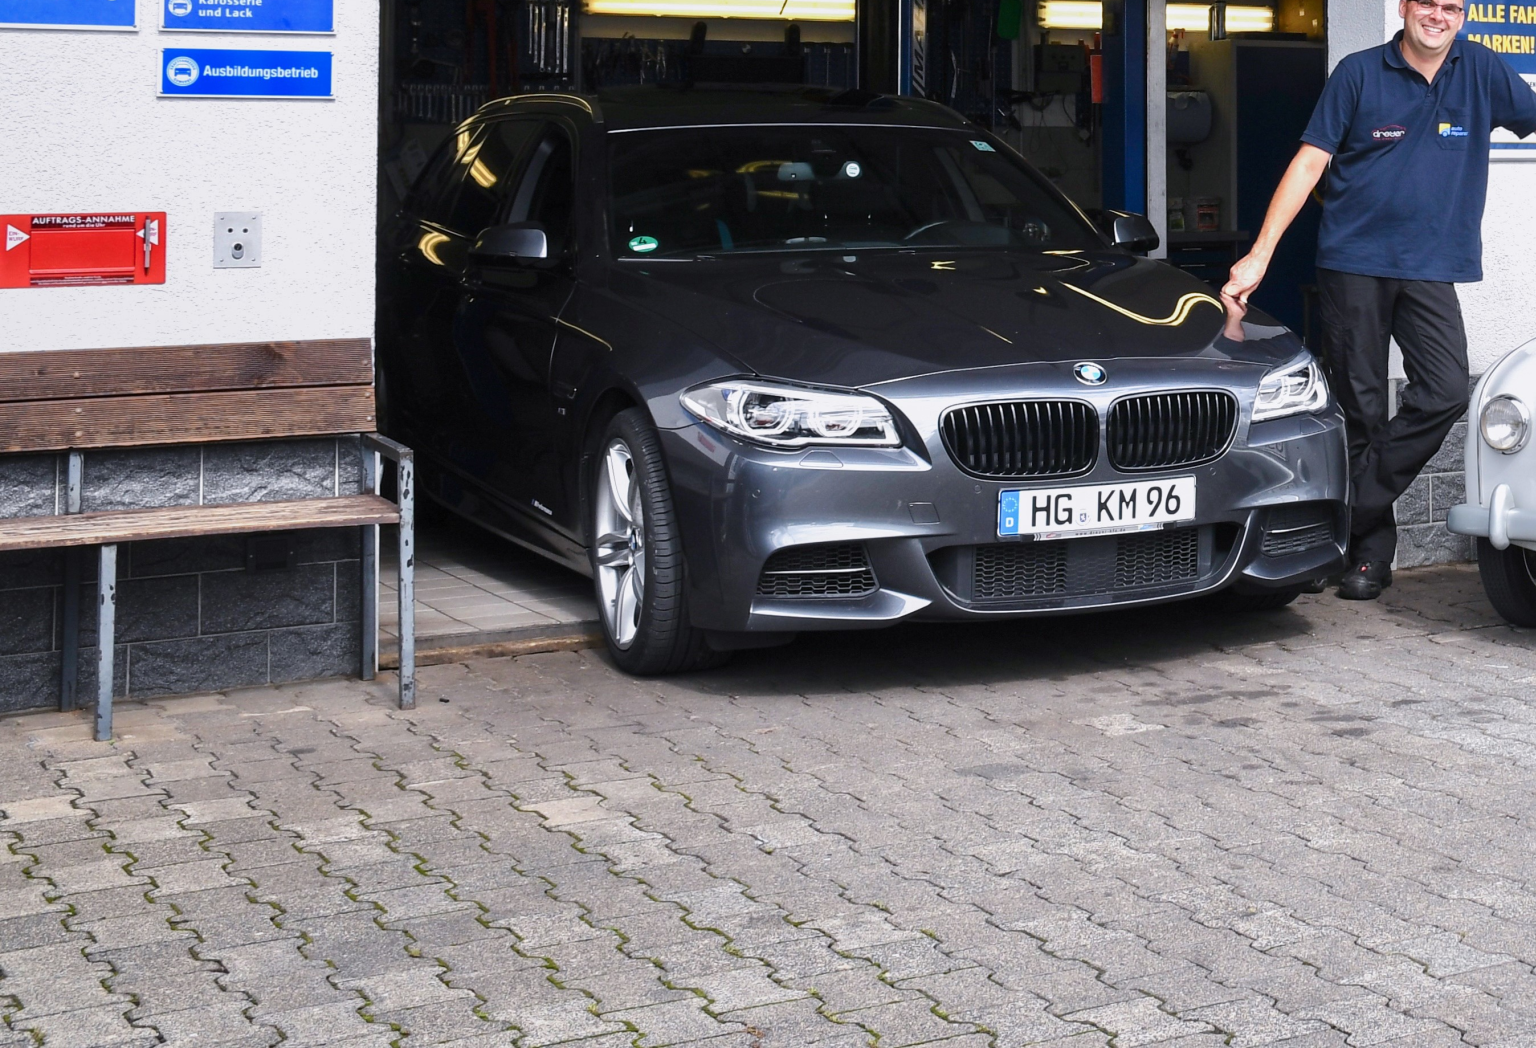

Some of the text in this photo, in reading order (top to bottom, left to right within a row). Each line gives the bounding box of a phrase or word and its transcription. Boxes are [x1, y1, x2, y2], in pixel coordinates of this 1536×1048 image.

[198, 7, 253, 18] und Lack
[1467, 4, 1505, 23] ALLE
[203, 65, 318, 79] Ausbildungsbetrieb
[32, 215, 135, 225] AUFTRAGS-ANNAHME
[1005, 484, 1181, 528] D HG KM 96
